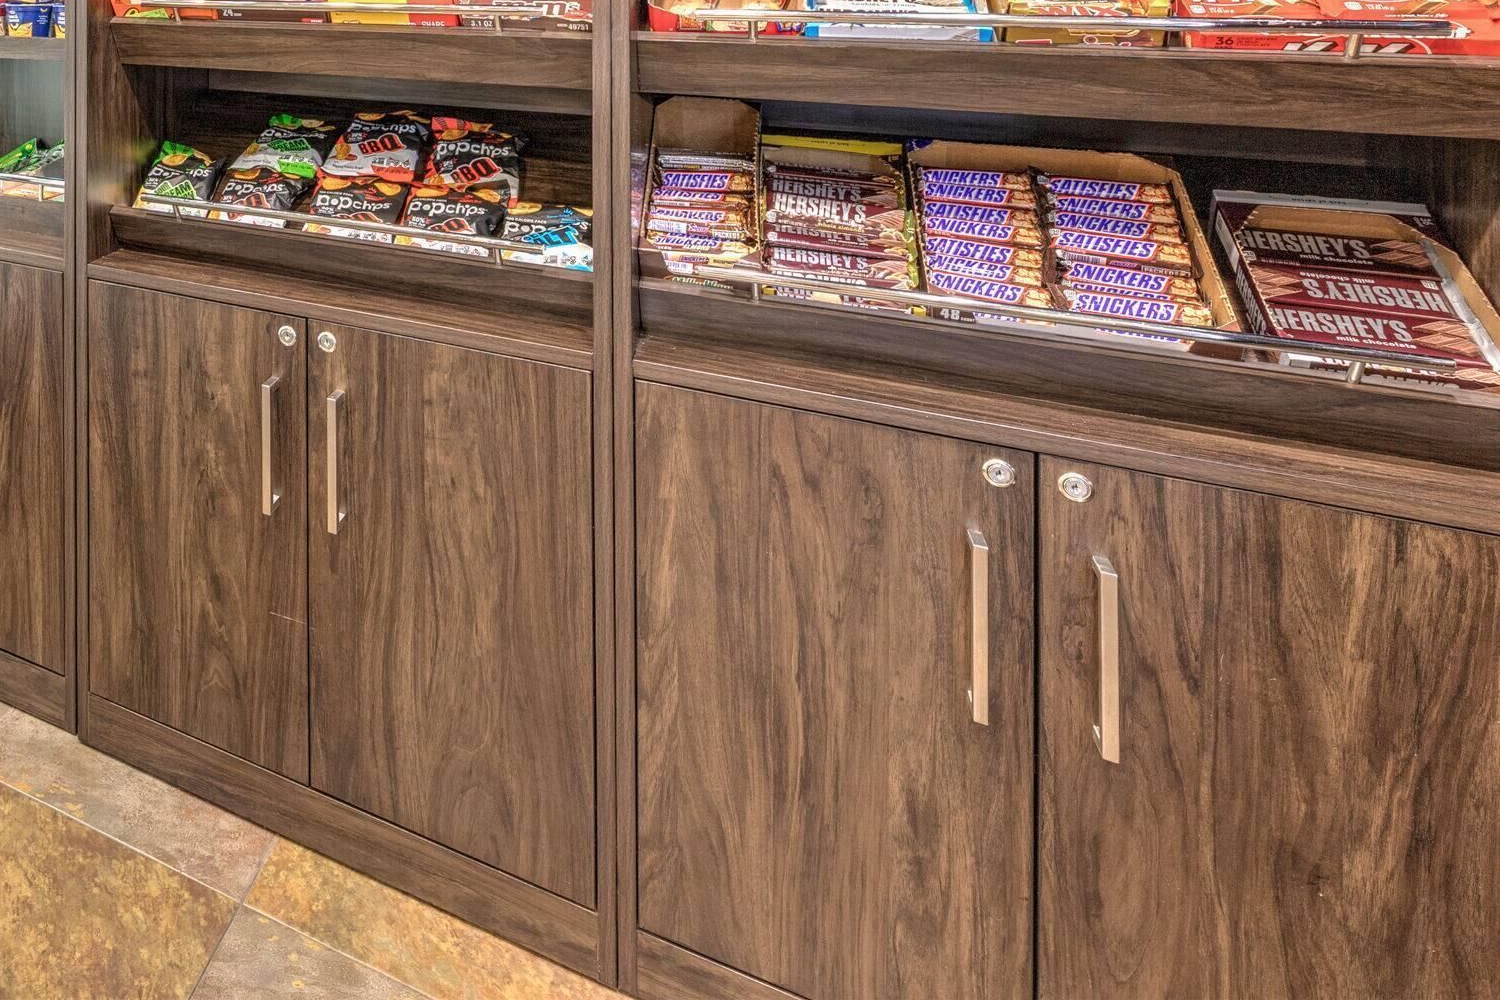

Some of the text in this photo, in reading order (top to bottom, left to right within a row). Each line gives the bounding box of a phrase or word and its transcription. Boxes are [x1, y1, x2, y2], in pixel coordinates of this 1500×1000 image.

[1215, 37, 1234, 46] 36
[437, 143, 510, 156] popchips
[450, 157, 502, 184] BBQ
[662, 173, 728, 188] SATISFIES
[922, 170, 1002, 187] SNICKERS
[772, 178, 862, 201] HERSHEY'S
[925, 183, 1008, 204] SNICKERS
[1050, 179, 1139, 200] SATISFIES
[407, 202, 484, 216] popchips
[773, 193, 867, 224] HERSHEY'S
[925, 202, 1009, 224] SATISFIES
[1056, 198, 1148, 219] SNICKERS
[838, 225, 864, 233] almonds
[927, 218, 1013, 240] SNICKERS
[1055, 213, 1150, 239] SNICKERS
[926, 237, 1012, 265] SATISFIES
[1057, 231, 1158, 259] SATISFIES
[1240, 230, 1372, 260] HERSHEY'S
[774, 247, 868, 270] HERSHEY'S
[1322, 255, 1374, 266] chocolate
[932, 273, 1023, 302] SNICKERS
[1070, 262, 1169, 292] SNICKERS
[1303, 278, 1450, 313] HERSHEY'S
[940, 308, 960, 321] 48
[1077, 294, 1177, 323] SNICKERS
[1272, 308, 1414, 343] HERSHEY'S
[1336, 336, 1417, 350] milk chocolate
